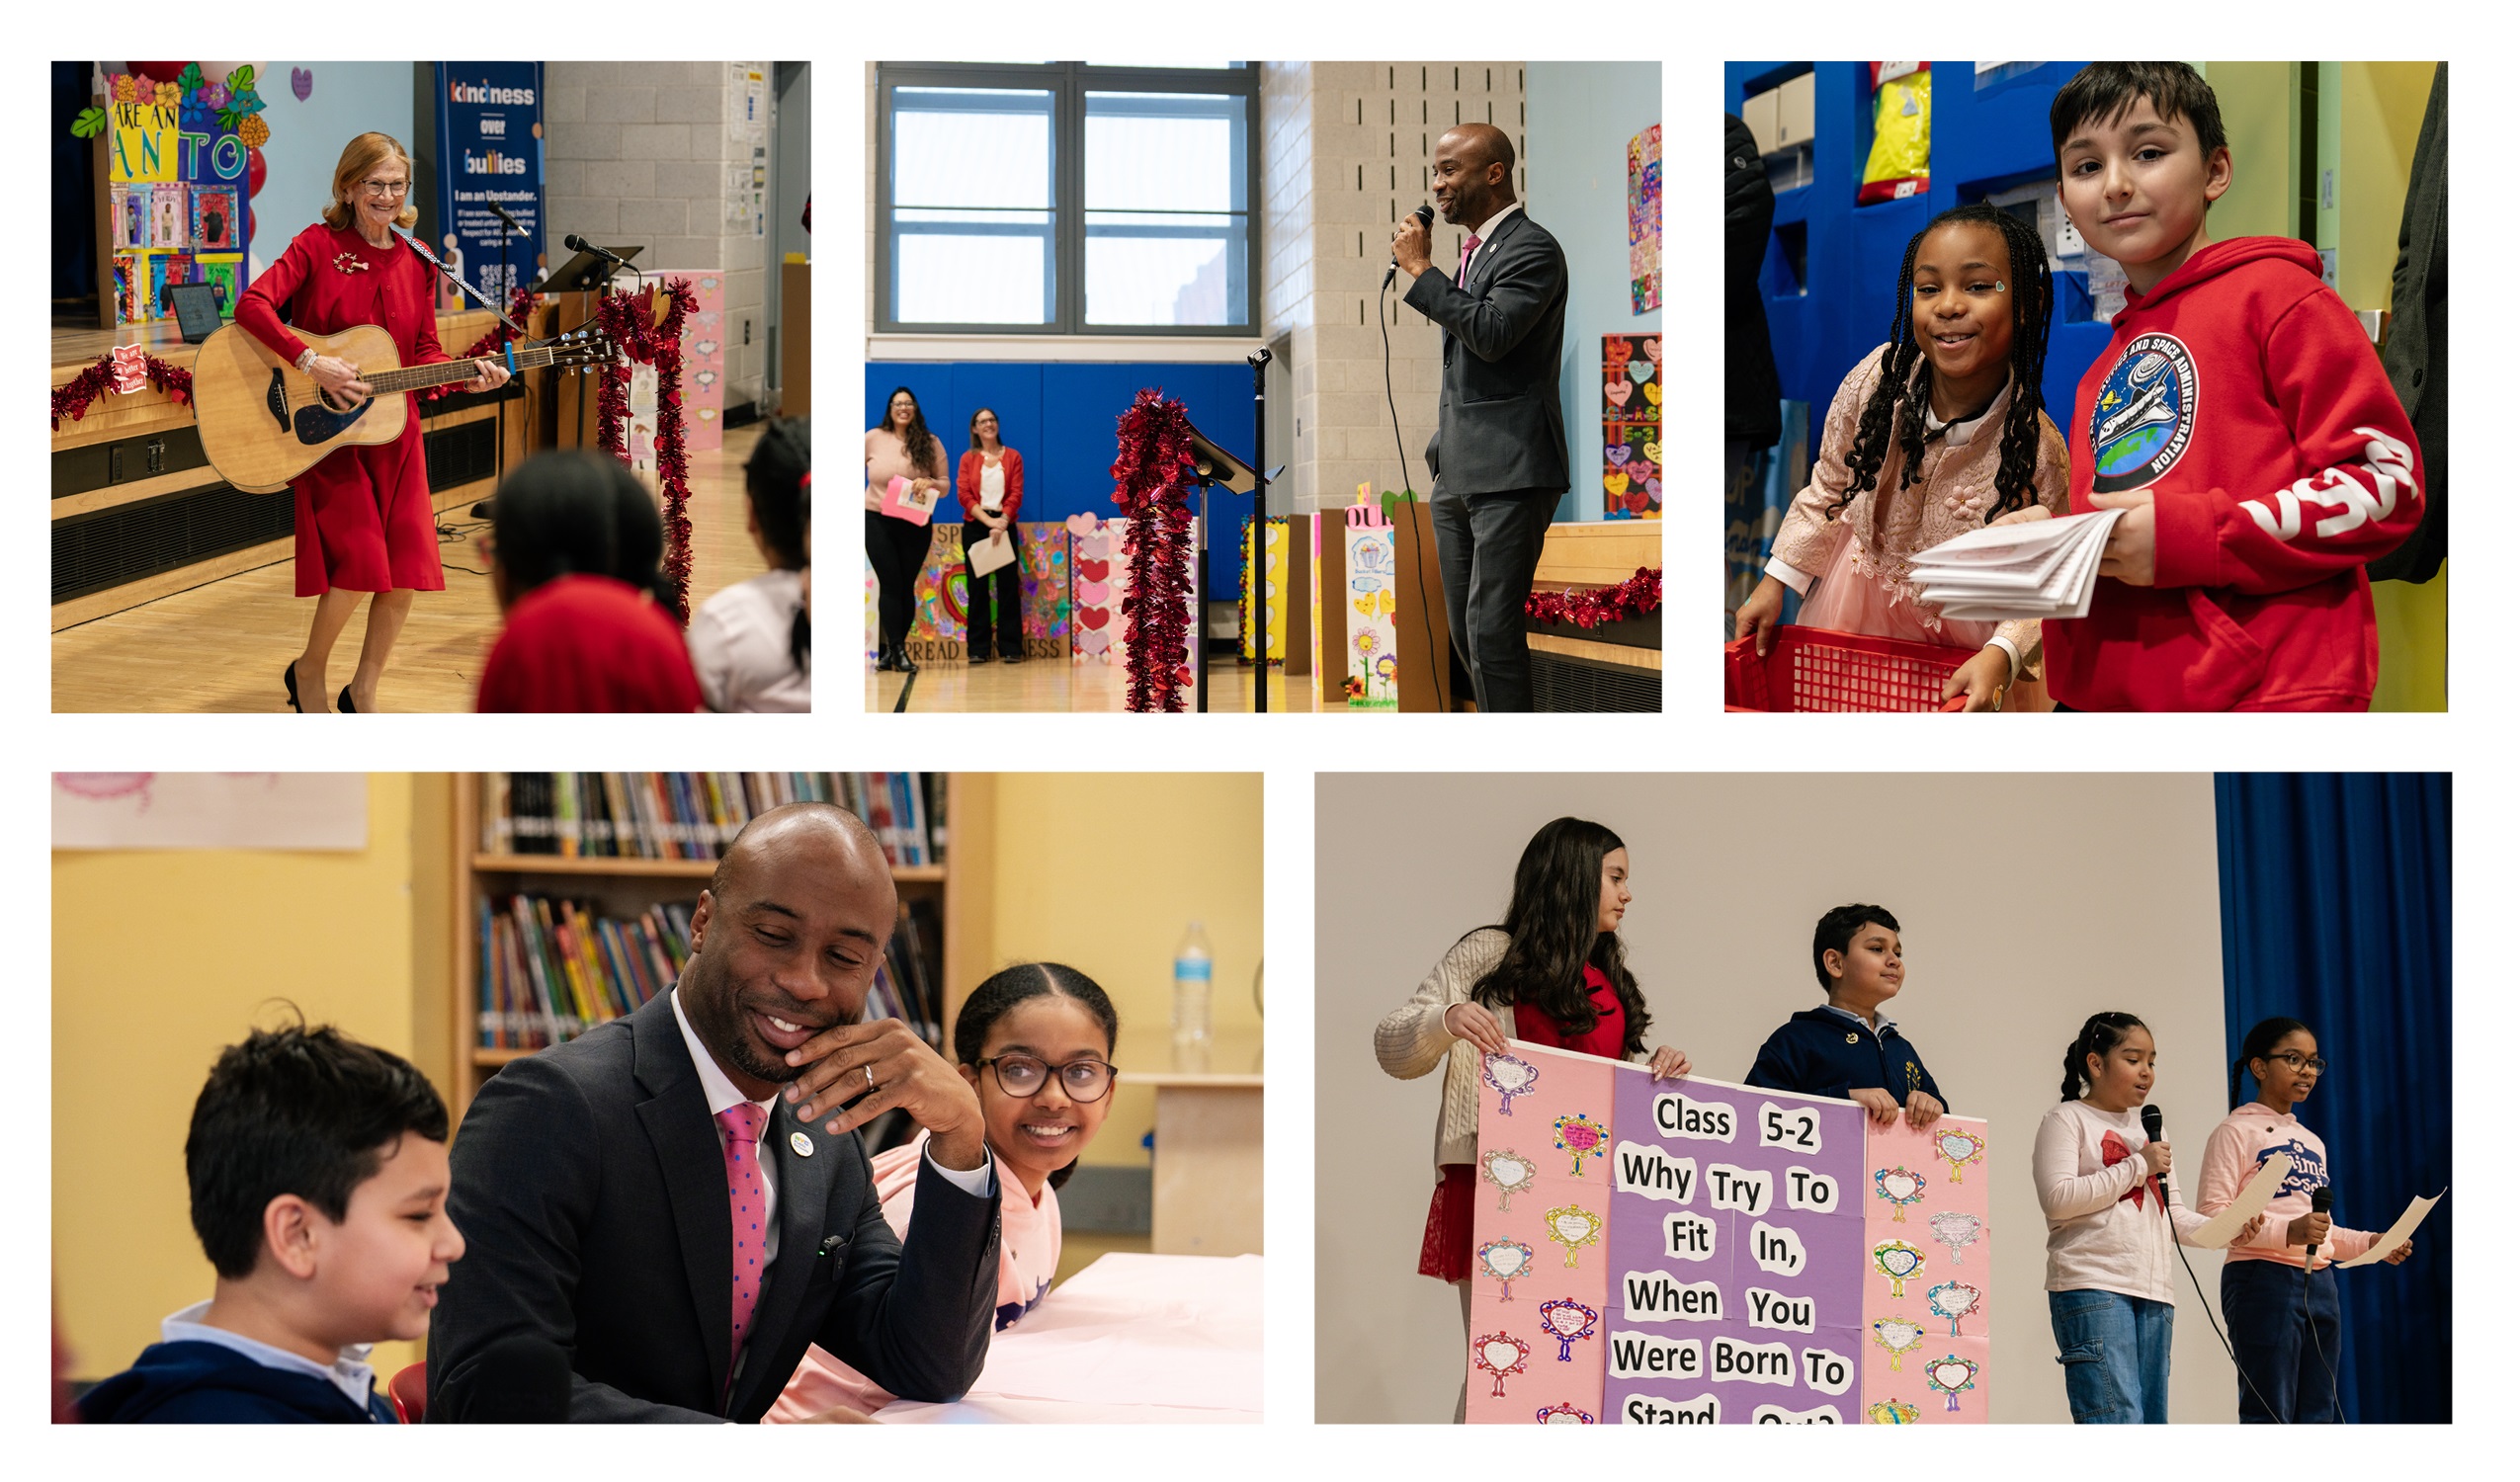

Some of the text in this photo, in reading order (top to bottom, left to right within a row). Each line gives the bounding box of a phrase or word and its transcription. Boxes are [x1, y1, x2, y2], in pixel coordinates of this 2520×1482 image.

[451, 78, 535, 105] kindness
[114, 102, 176, 129] ARE AN
[480, 120, 506, 134] over
[464, 148, 526, 175] bullies
[460, 192, 473, 202] am
[473, 192, 485, 202] an
[2129, 338, 2150, 355] AND
[2150, 338, 2181, 360] SPACE
[1606, 405, 1662, 422] CLAS
[2150, 356, 2193, 474] ADMINISTRATION
[904, 641, 960, 661] PREAD
[1657, 1098, 1814, 1147] Class 5-2
[1623, 1153, 1829, 1211] Why Try To
[1672, 1221, 1797, 1269] Fit In,
[1628, 1278, 1810, 1326] When You
[1613, 1340, 1844, 1385] Were Born To
[1628, 1400, 1715, 1424] Stand
